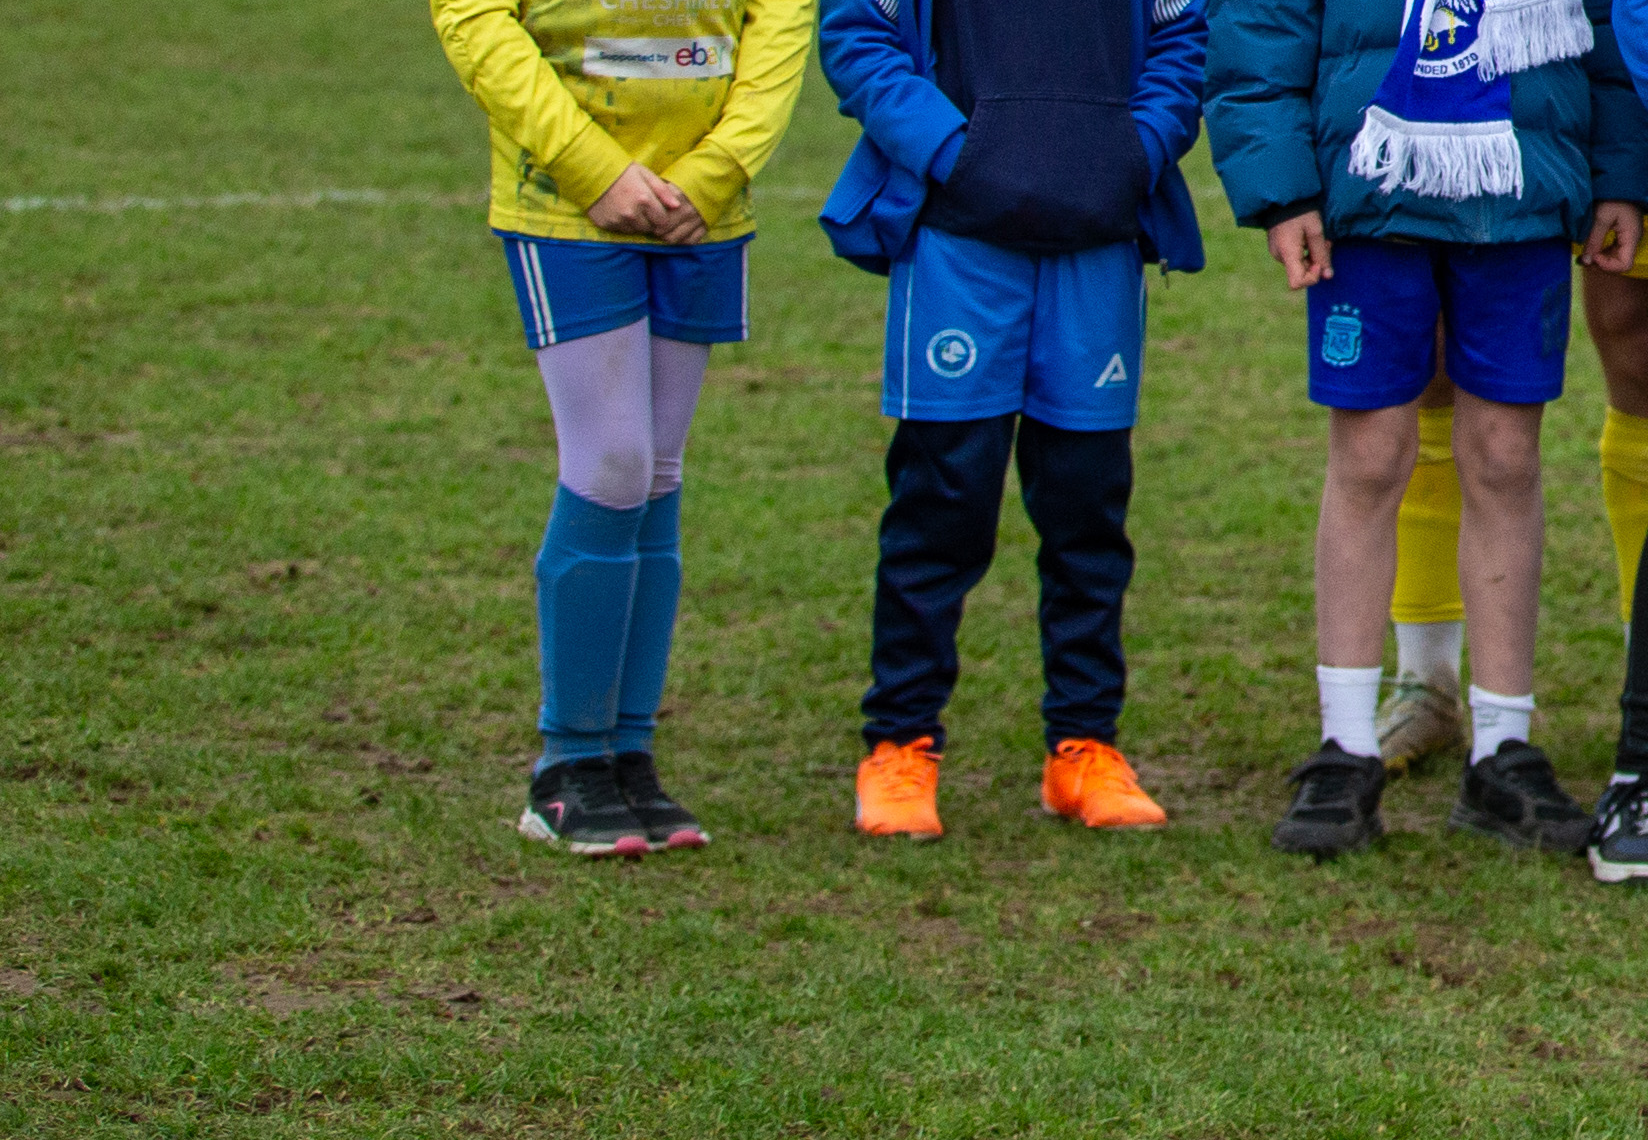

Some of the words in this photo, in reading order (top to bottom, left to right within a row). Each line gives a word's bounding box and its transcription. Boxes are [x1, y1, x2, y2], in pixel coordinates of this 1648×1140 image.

[599, 50, 654, 65] Supported
[656, 52, 669, 66] by
[674, 41, 726, 71] ebay
[1416, 64, 1449, 76] NDED
[1452, 52, 1479, 72] 1870
